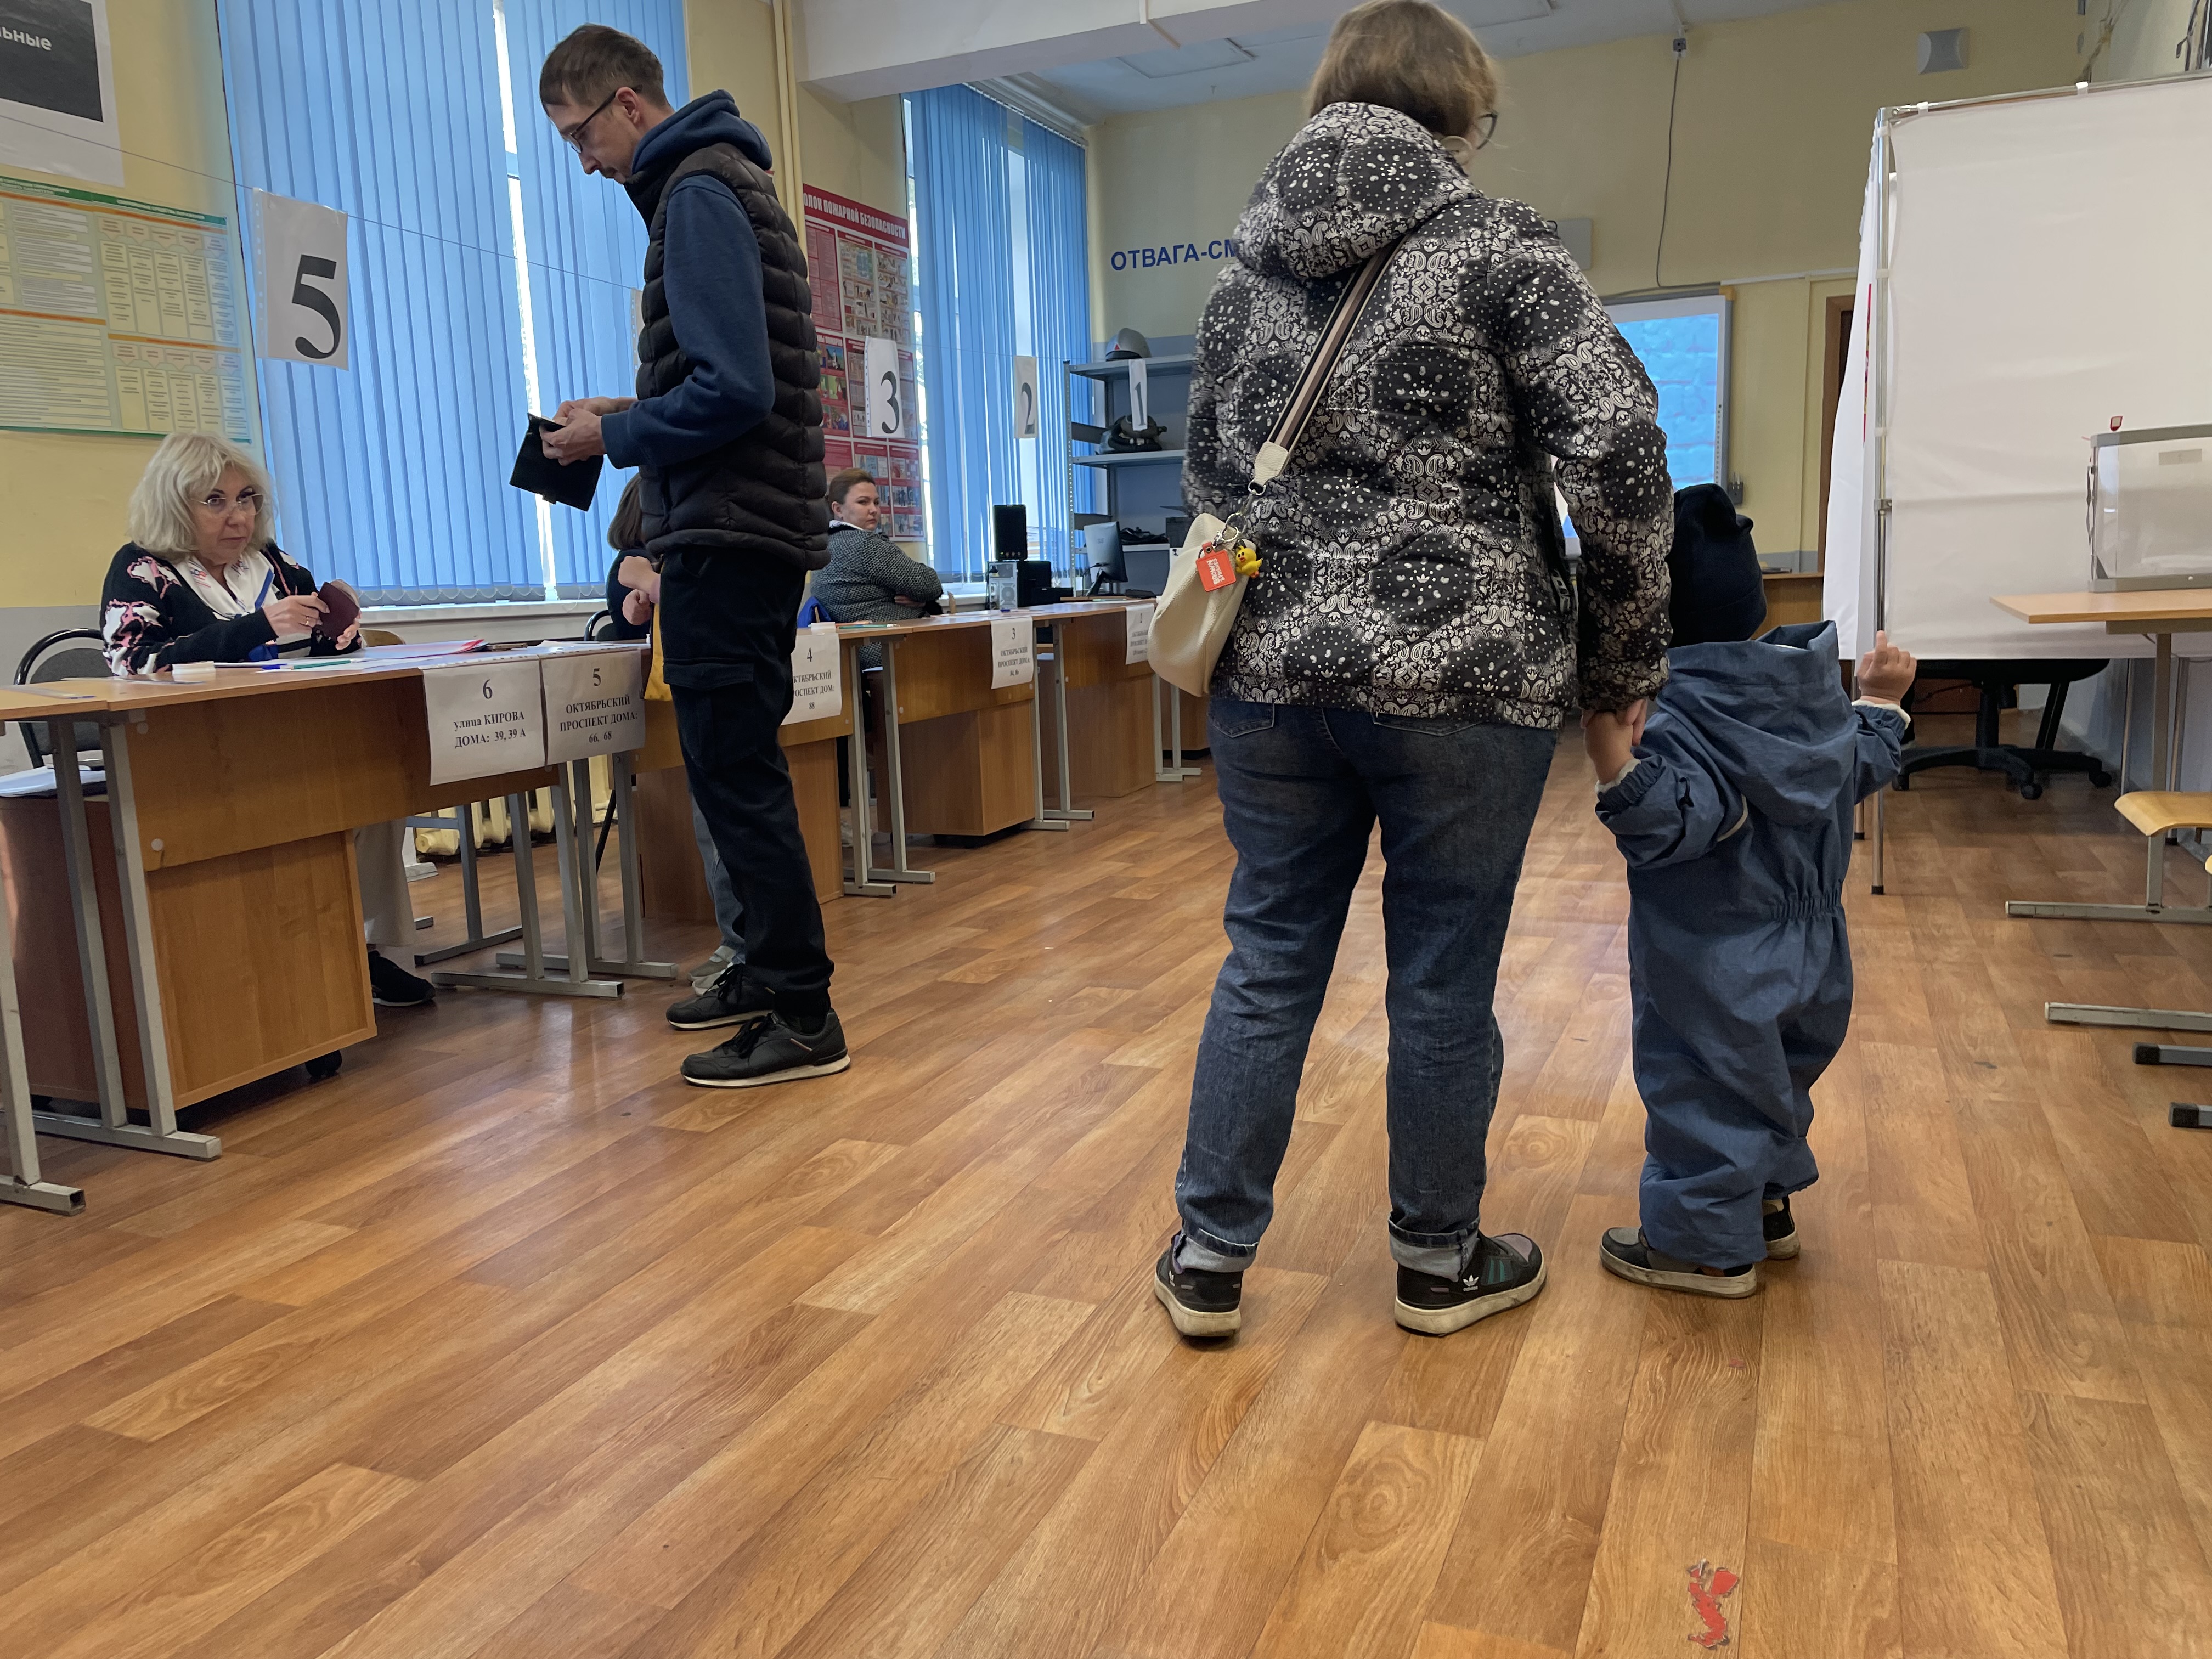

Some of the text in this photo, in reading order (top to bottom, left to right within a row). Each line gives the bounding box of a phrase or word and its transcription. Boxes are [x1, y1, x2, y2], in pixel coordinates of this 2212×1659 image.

[0, 27, 52, 50] ьные
[803, 193, 822, 211] ОЛОК
[823, 199, 859, 223] ПОЖАРНОЙ
[860, 212, 905, 239] БЕЗОПАСНОСТИ
[291, 254, 341, 359] 5
[881, 371, 900, 434] 3
[1022, 382, 1035, 435] 2
[1135, 382, 1147, 426] 1
[1206, 559, 1221, 585] BROWN
[1012, 628, 1015, 640] 3
[806, 647, 812, 662] 4
[592, 668, 601, 686] 5
[793, 670, 832, 684] КТЯБРЬСКИЙ
[483, 679, 493, 699] 6
[794, 686, 819, 697] ОСПЕКТ
[566, 694, 630, 714] ОКТЯБРЬСКИЙ
[809, 702, 815, 710] 88
[454, 711, 524, 732] улица КИРОВА
[560, 712, 638, 732] ПРОСПЕКТ ДОМА:
[455, 728, 526, 749] ДОМА: 39, 39 А
[589, 730, 612, 743] 66, 68
